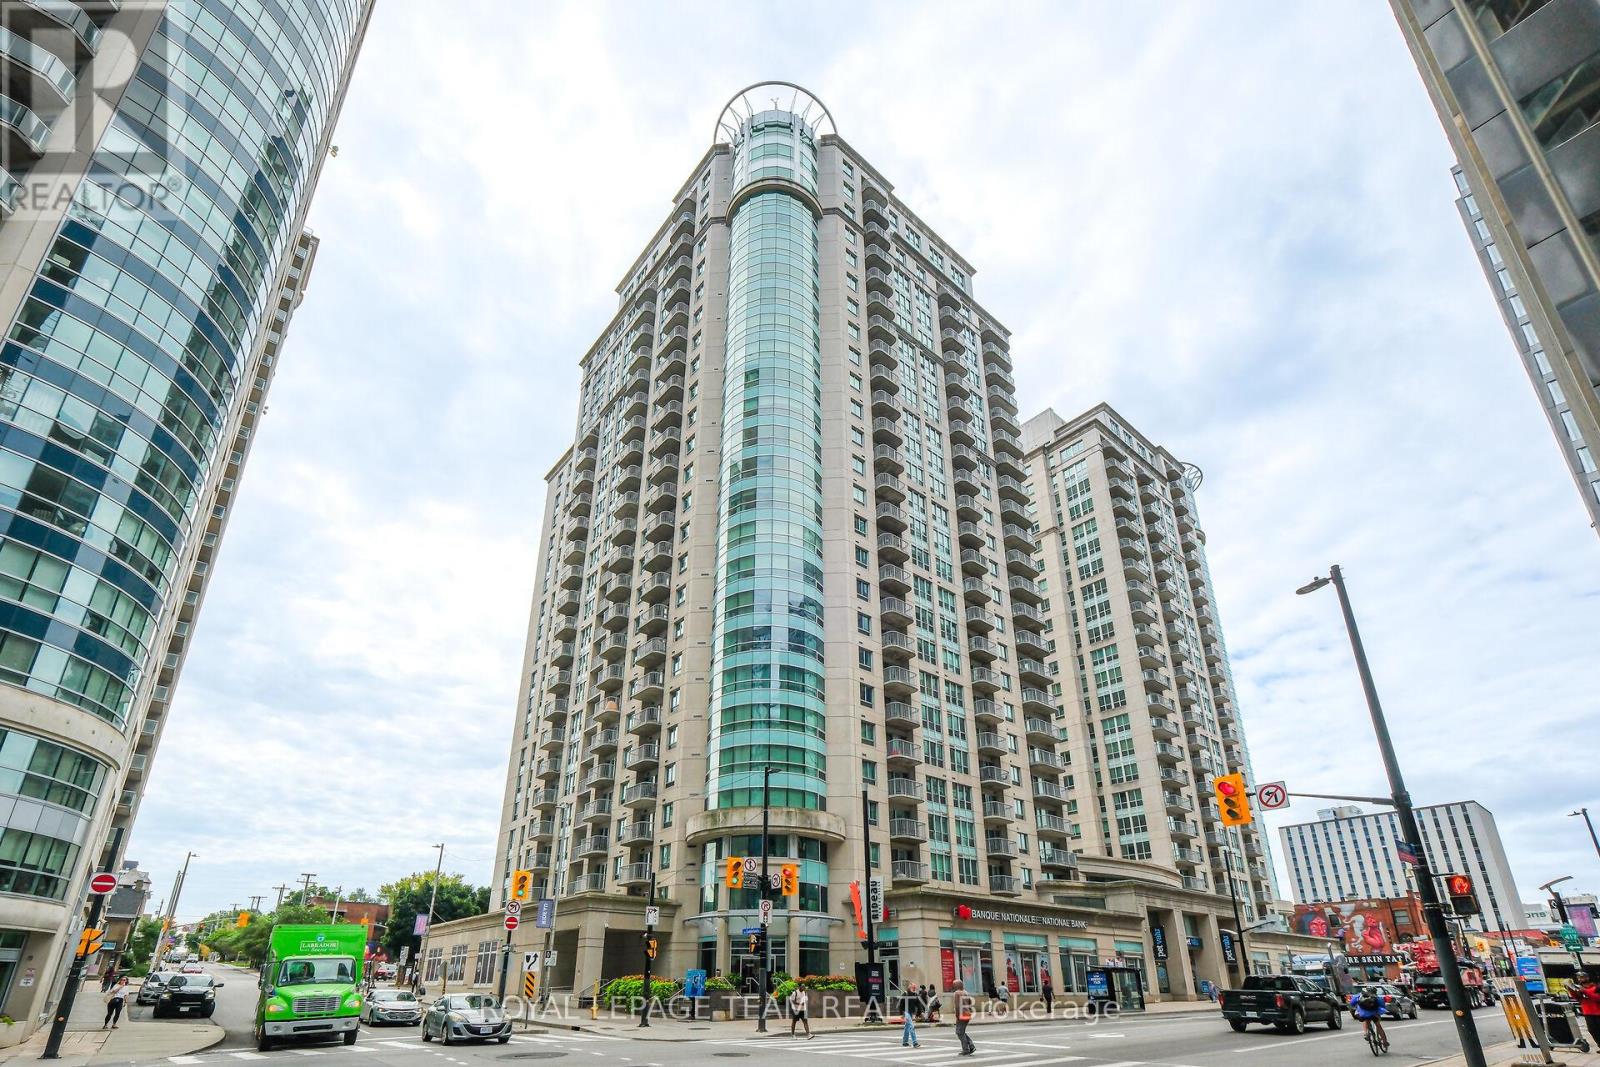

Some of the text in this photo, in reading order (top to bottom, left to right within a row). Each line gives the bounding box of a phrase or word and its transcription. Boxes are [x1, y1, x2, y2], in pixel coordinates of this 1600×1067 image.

[971, 909, 1000, 920] BANQUE
[1001, 912, 1035, 924] NATIONALE
[1042, 916, 1071, 927] NATIONAL
[1071, 919, 1087, 929] BANK
[1154, 927, 1167, 958] pet valu
[1222, 935, 1235, 961] pet valu
[1361, 955, 1383, 963] SKIN
